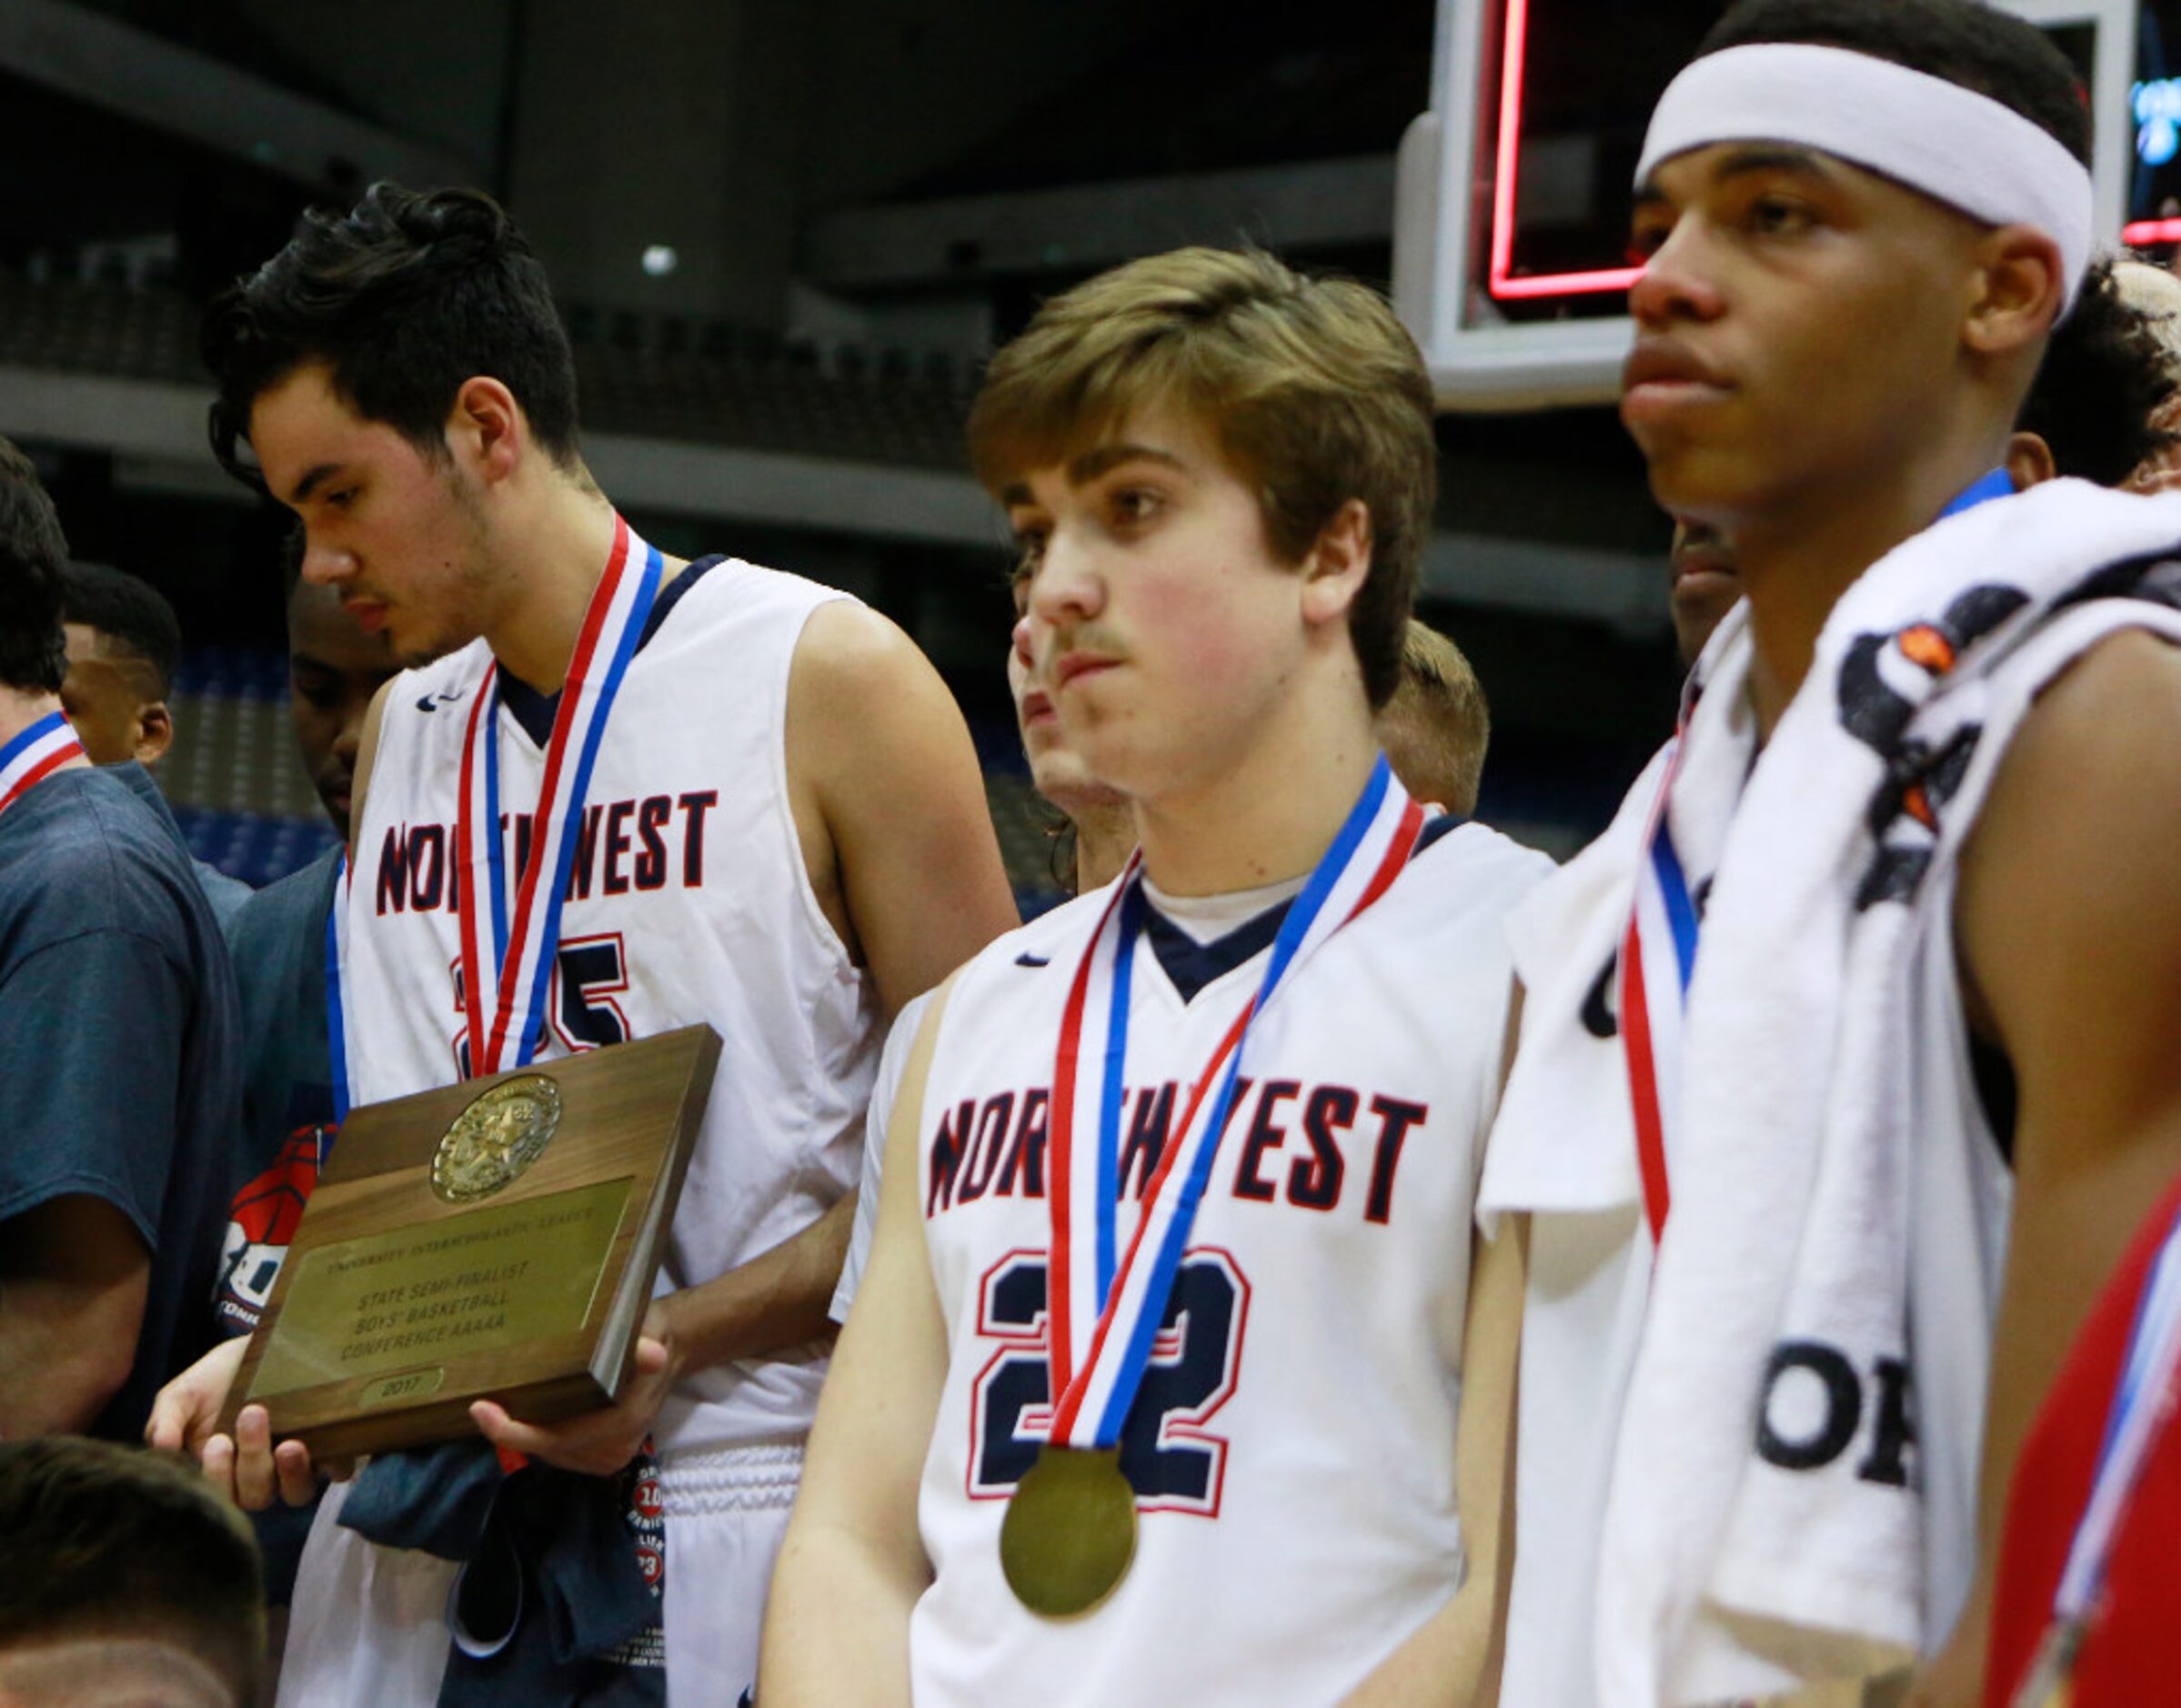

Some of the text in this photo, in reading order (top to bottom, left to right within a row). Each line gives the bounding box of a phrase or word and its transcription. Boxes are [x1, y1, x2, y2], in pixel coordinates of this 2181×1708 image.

[357, 1260, 530, 1311] STATE SEMI-FINALIST
[406, 1291, 508, 1324] BASKETBALL
[341, 1313, 506, 1361] CONFERENCE AAAAA
[380, 1375, 422, 1398] 2017
